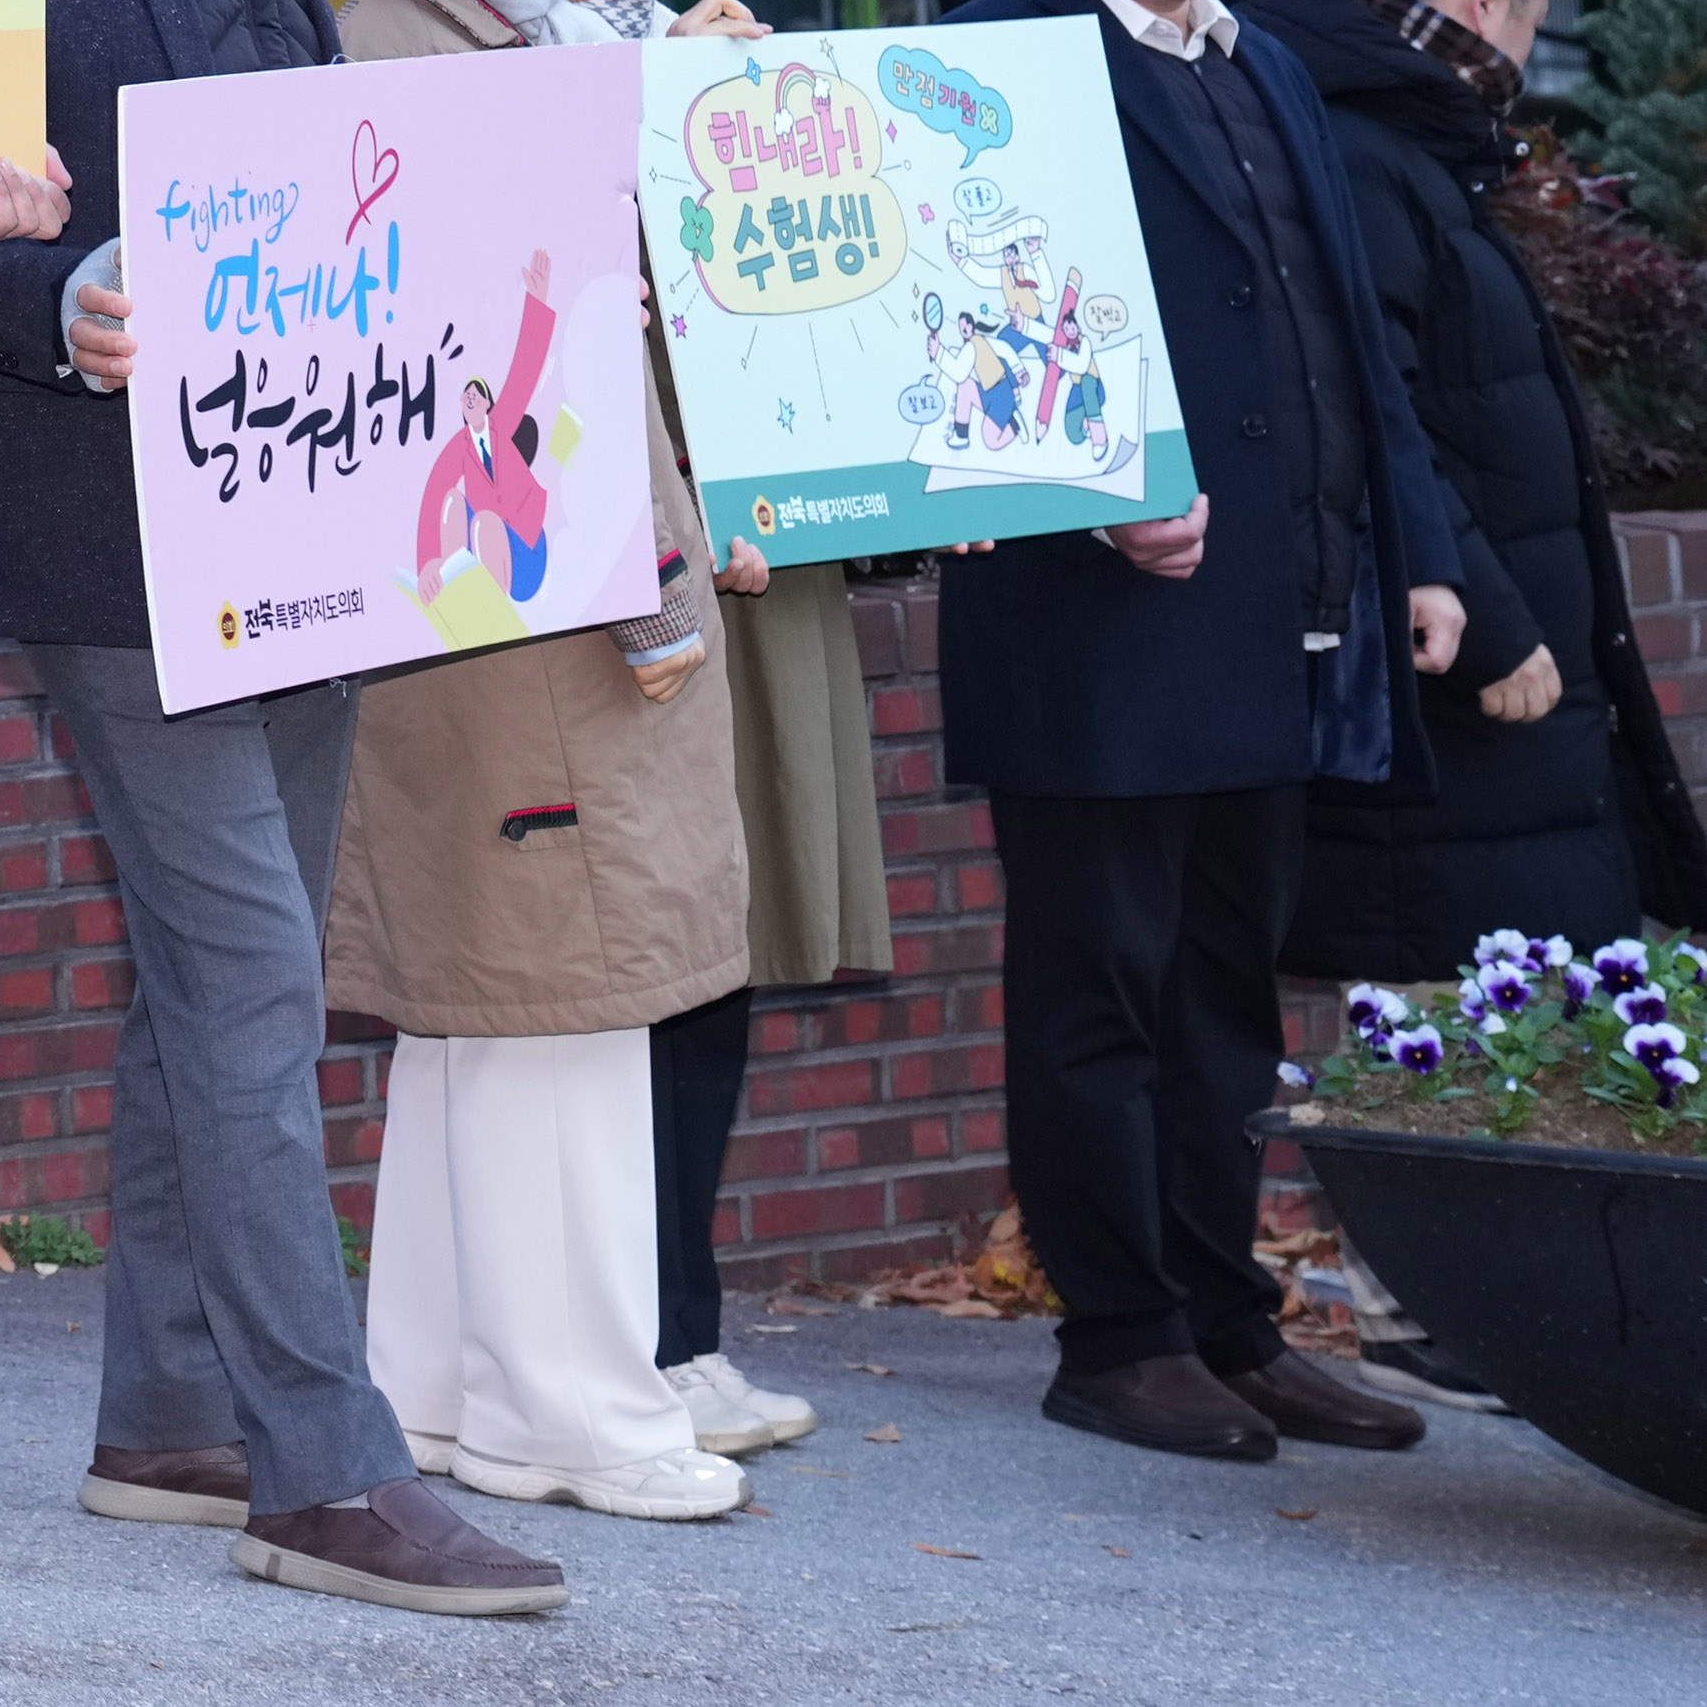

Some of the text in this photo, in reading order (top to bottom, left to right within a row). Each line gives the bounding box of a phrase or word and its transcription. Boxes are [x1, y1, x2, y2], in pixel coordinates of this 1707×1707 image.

[708, 95, 862, 193] 힘내라!
[156, 172, 299, 253] fighting
[733, 194, 879, 292] 수험생!
[205, 220, 400, 338] 언제나!
[777, 493, 890, 529] 전북특별자치도의회
[244, 587, 365, 639] 전북특별자치도의회
